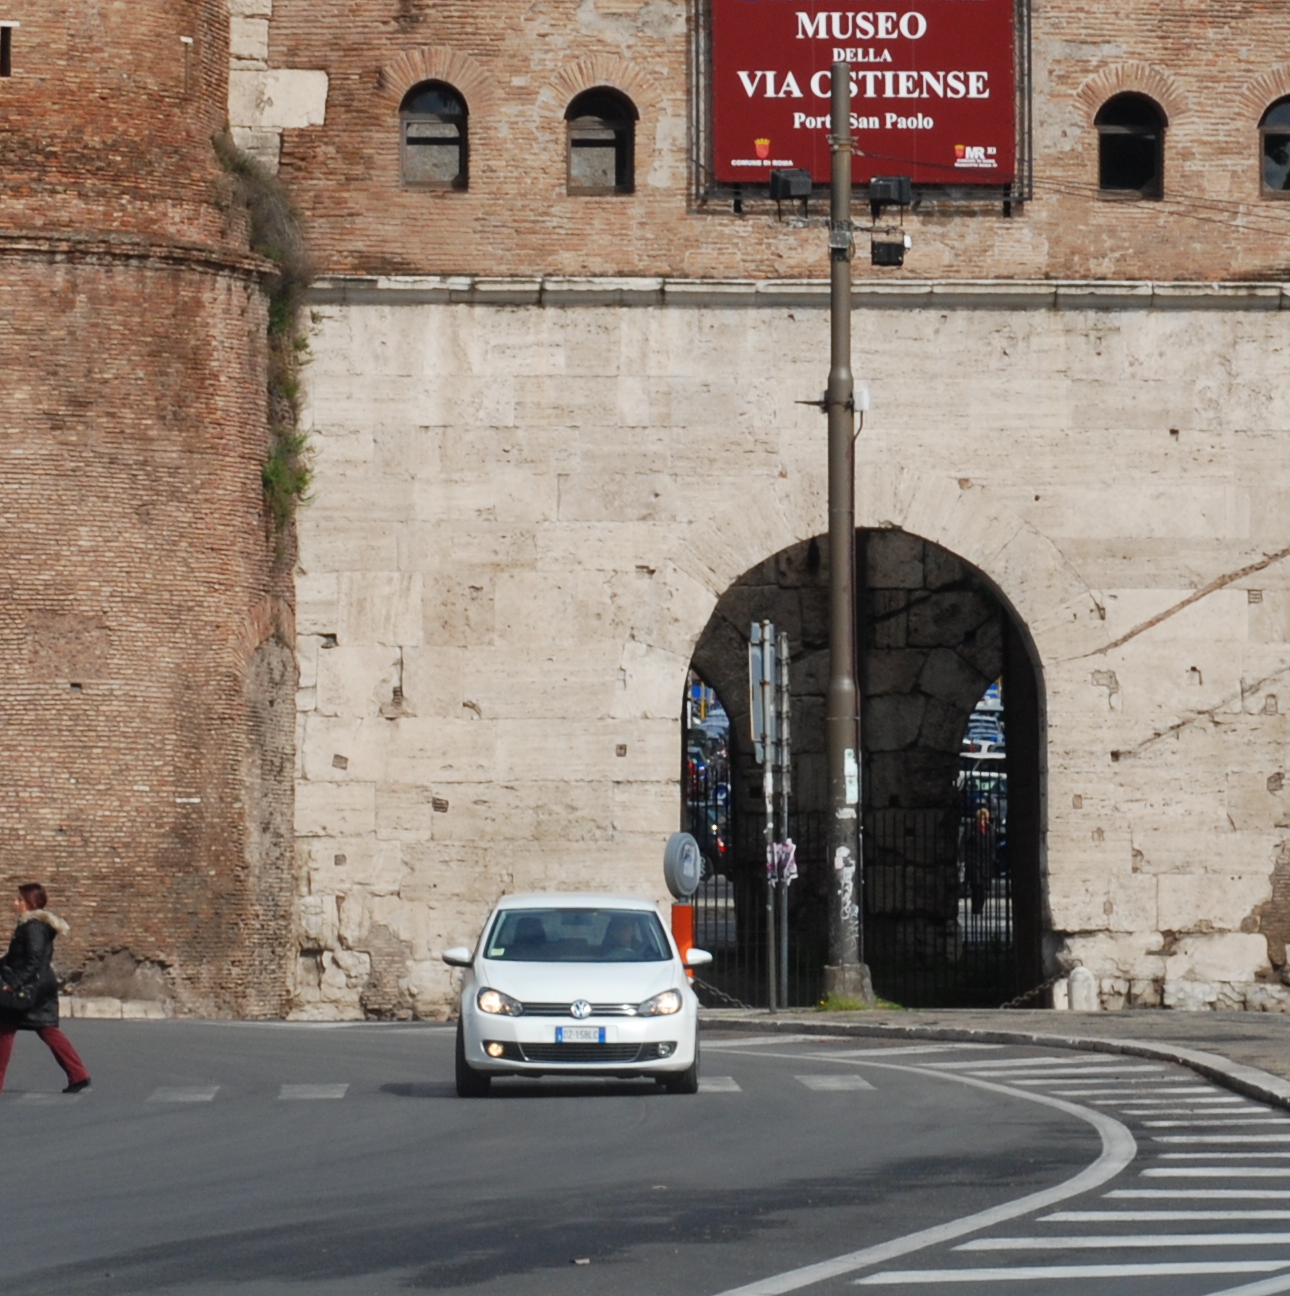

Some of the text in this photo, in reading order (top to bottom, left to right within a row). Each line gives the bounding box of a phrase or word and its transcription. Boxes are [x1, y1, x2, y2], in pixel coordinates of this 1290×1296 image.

[794, 11, 928, 40] MUSEO
[832, 47, 893, 63] DELLA
[736, 70, 804, 98] VIA
[792, 111, 935, 130] Port San Paolo
